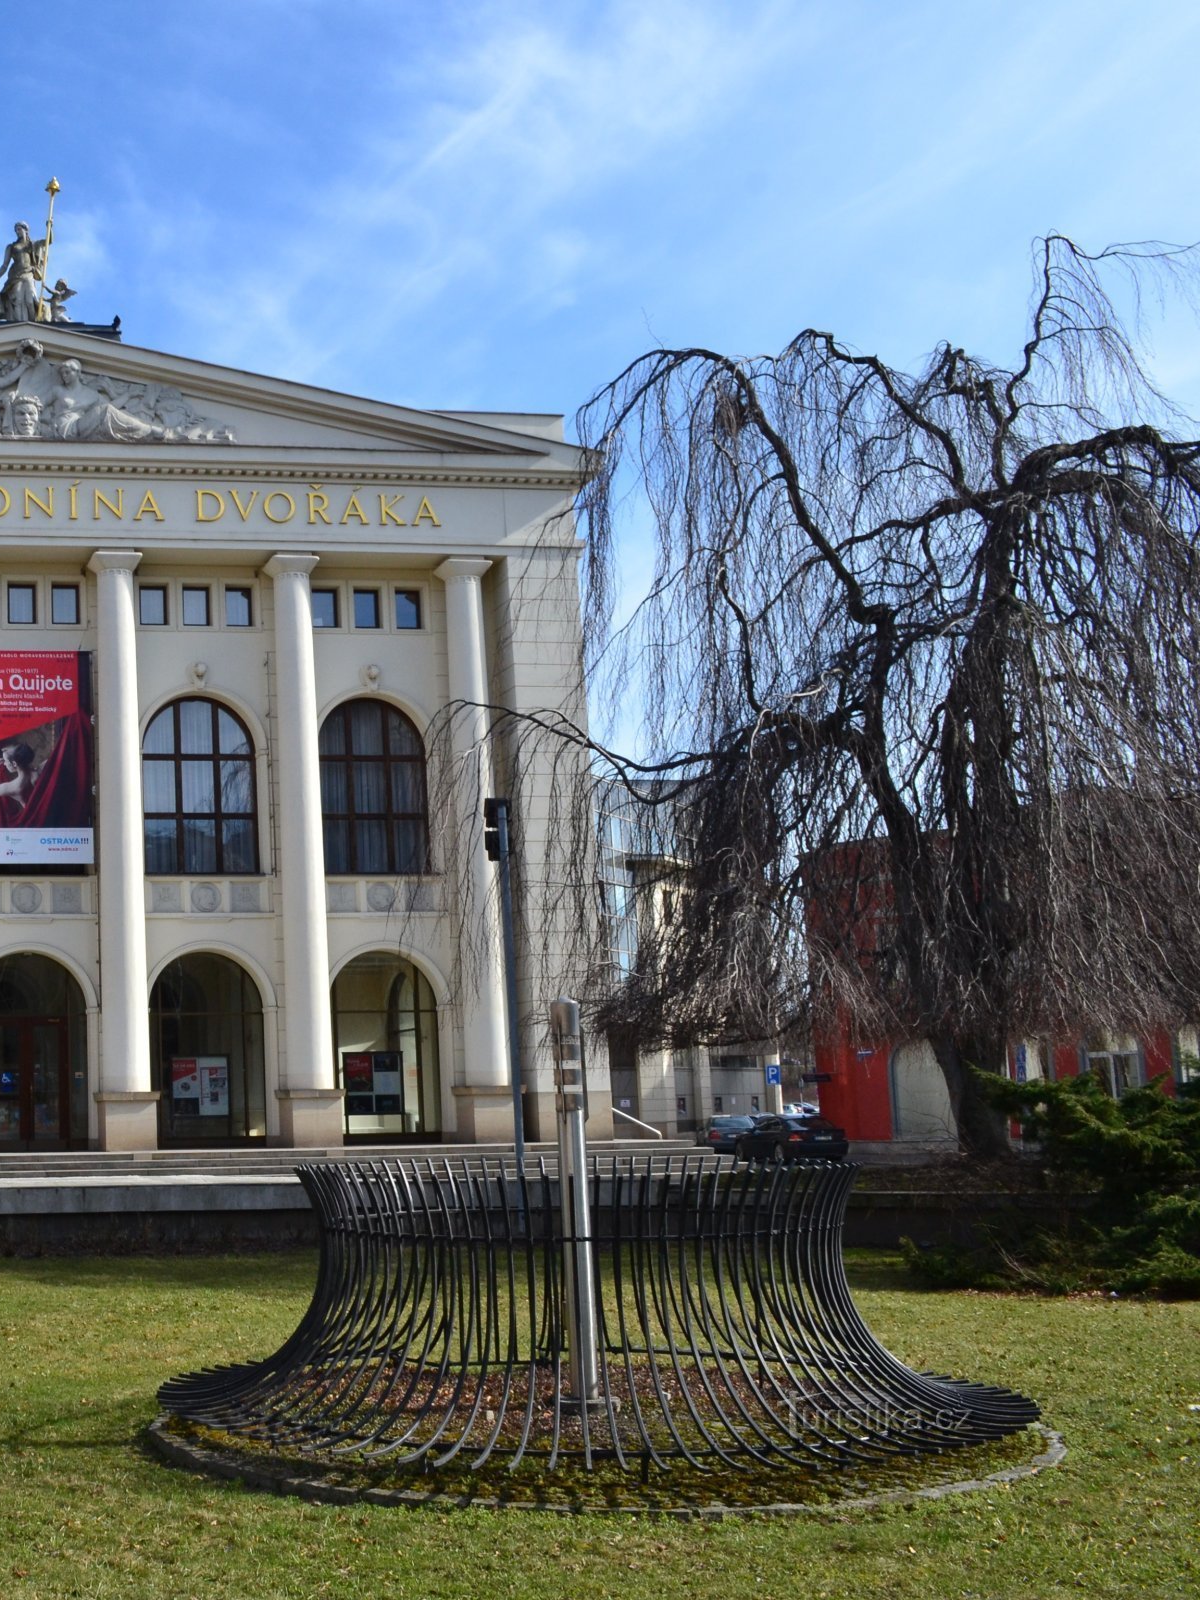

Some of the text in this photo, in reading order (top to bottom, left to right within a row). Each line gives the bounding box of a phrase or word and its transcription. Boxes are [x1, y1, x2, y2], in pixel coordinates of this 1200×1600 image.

[195, 483, 442, 527] DVOŘÁKA
[9, 674, 73, 693] Quijote
[40, 837, 89, 845] OSTRAVA!!!
[768, 1067, 777, 1079] P
